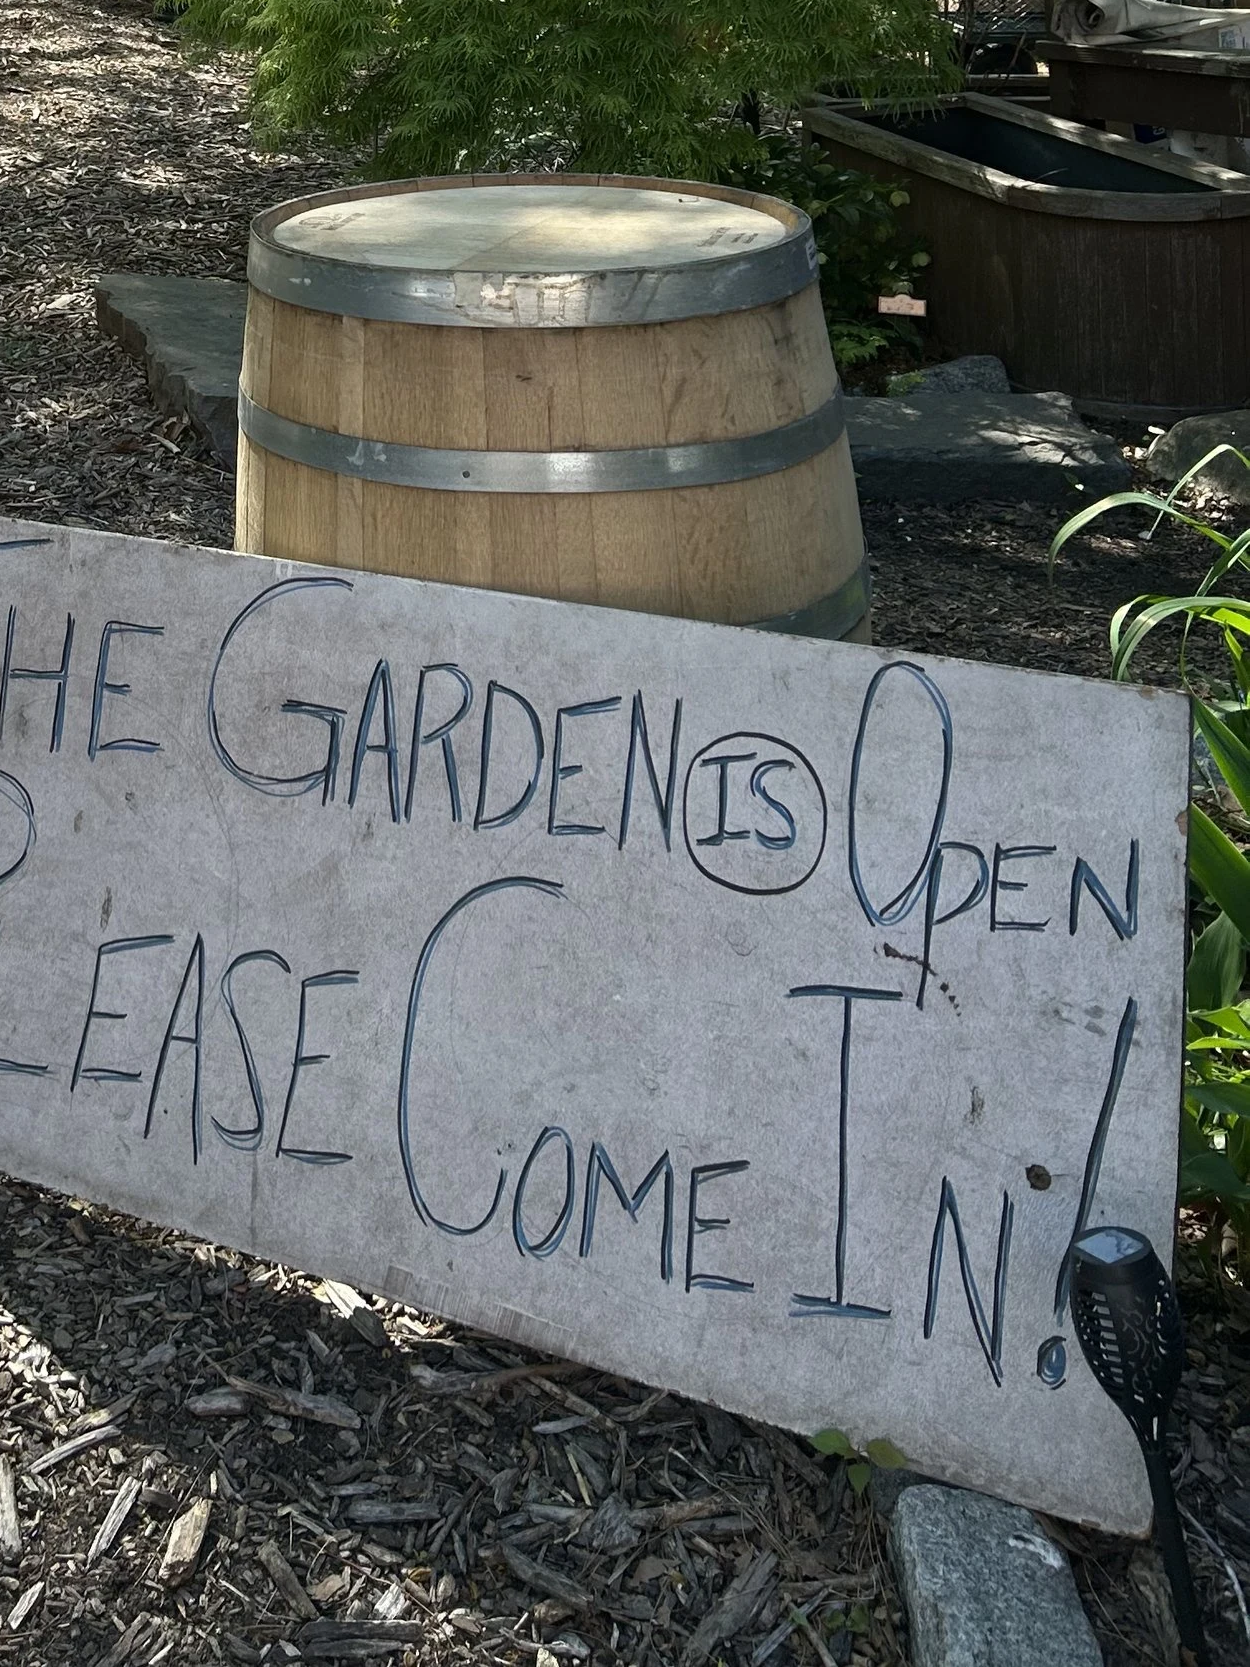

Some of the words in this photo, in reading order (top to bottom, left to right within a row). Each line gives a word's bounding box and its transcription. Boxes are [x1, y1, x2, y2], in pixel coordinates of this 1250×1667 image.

[207, 576, 683, 852] GARDEN
[696, 752, 797, 850] IS
[848, 660, 1140, 1010] OPEN
[398, 875, 755, 1293] COME
[786, 983, 1140, 1389] IN!
